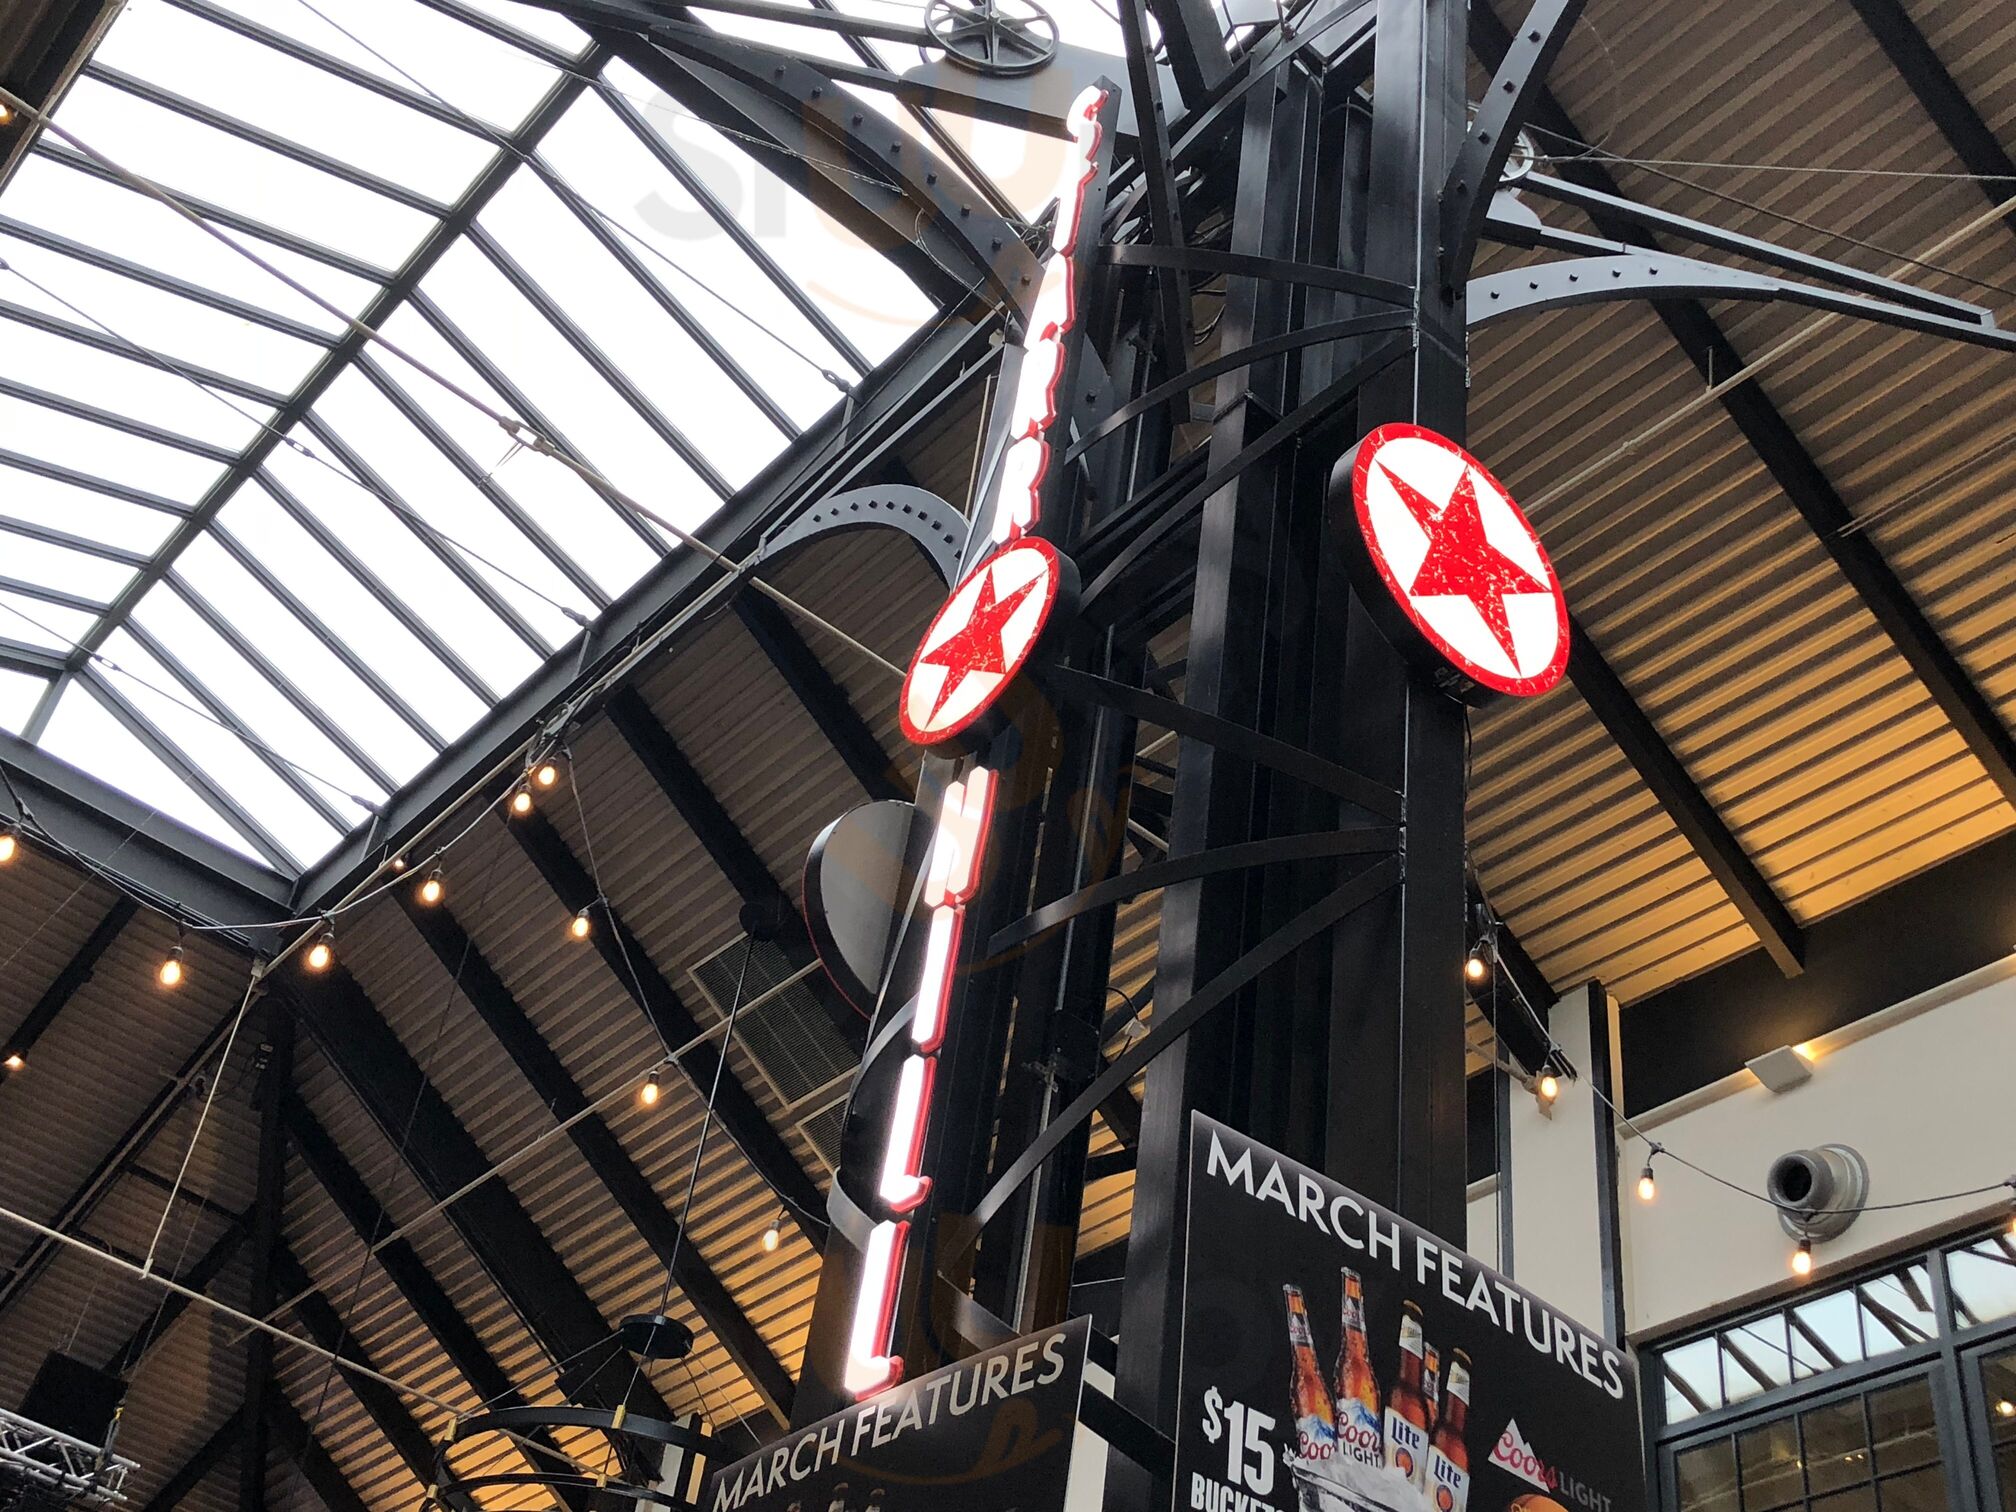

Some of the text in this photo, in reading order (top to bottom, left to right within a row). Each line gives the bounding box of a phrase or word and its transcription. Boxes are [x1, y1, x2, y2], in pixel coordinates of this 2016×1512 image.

[1207, 1129, 1624, 1399] MARCH FEATURES
[712, 1333, 1066, 1512] MARCH FEATURES
[1202, 1385, 1276, 1496] $15
[1343, 1442, 1380, 1468] LIGHT
[1391, 1417, 1420, 1450] Lite
[1433, 1454, 1462, 1488] Lite
[1493, 1431, 1612, 1512] Coors LIGHT
